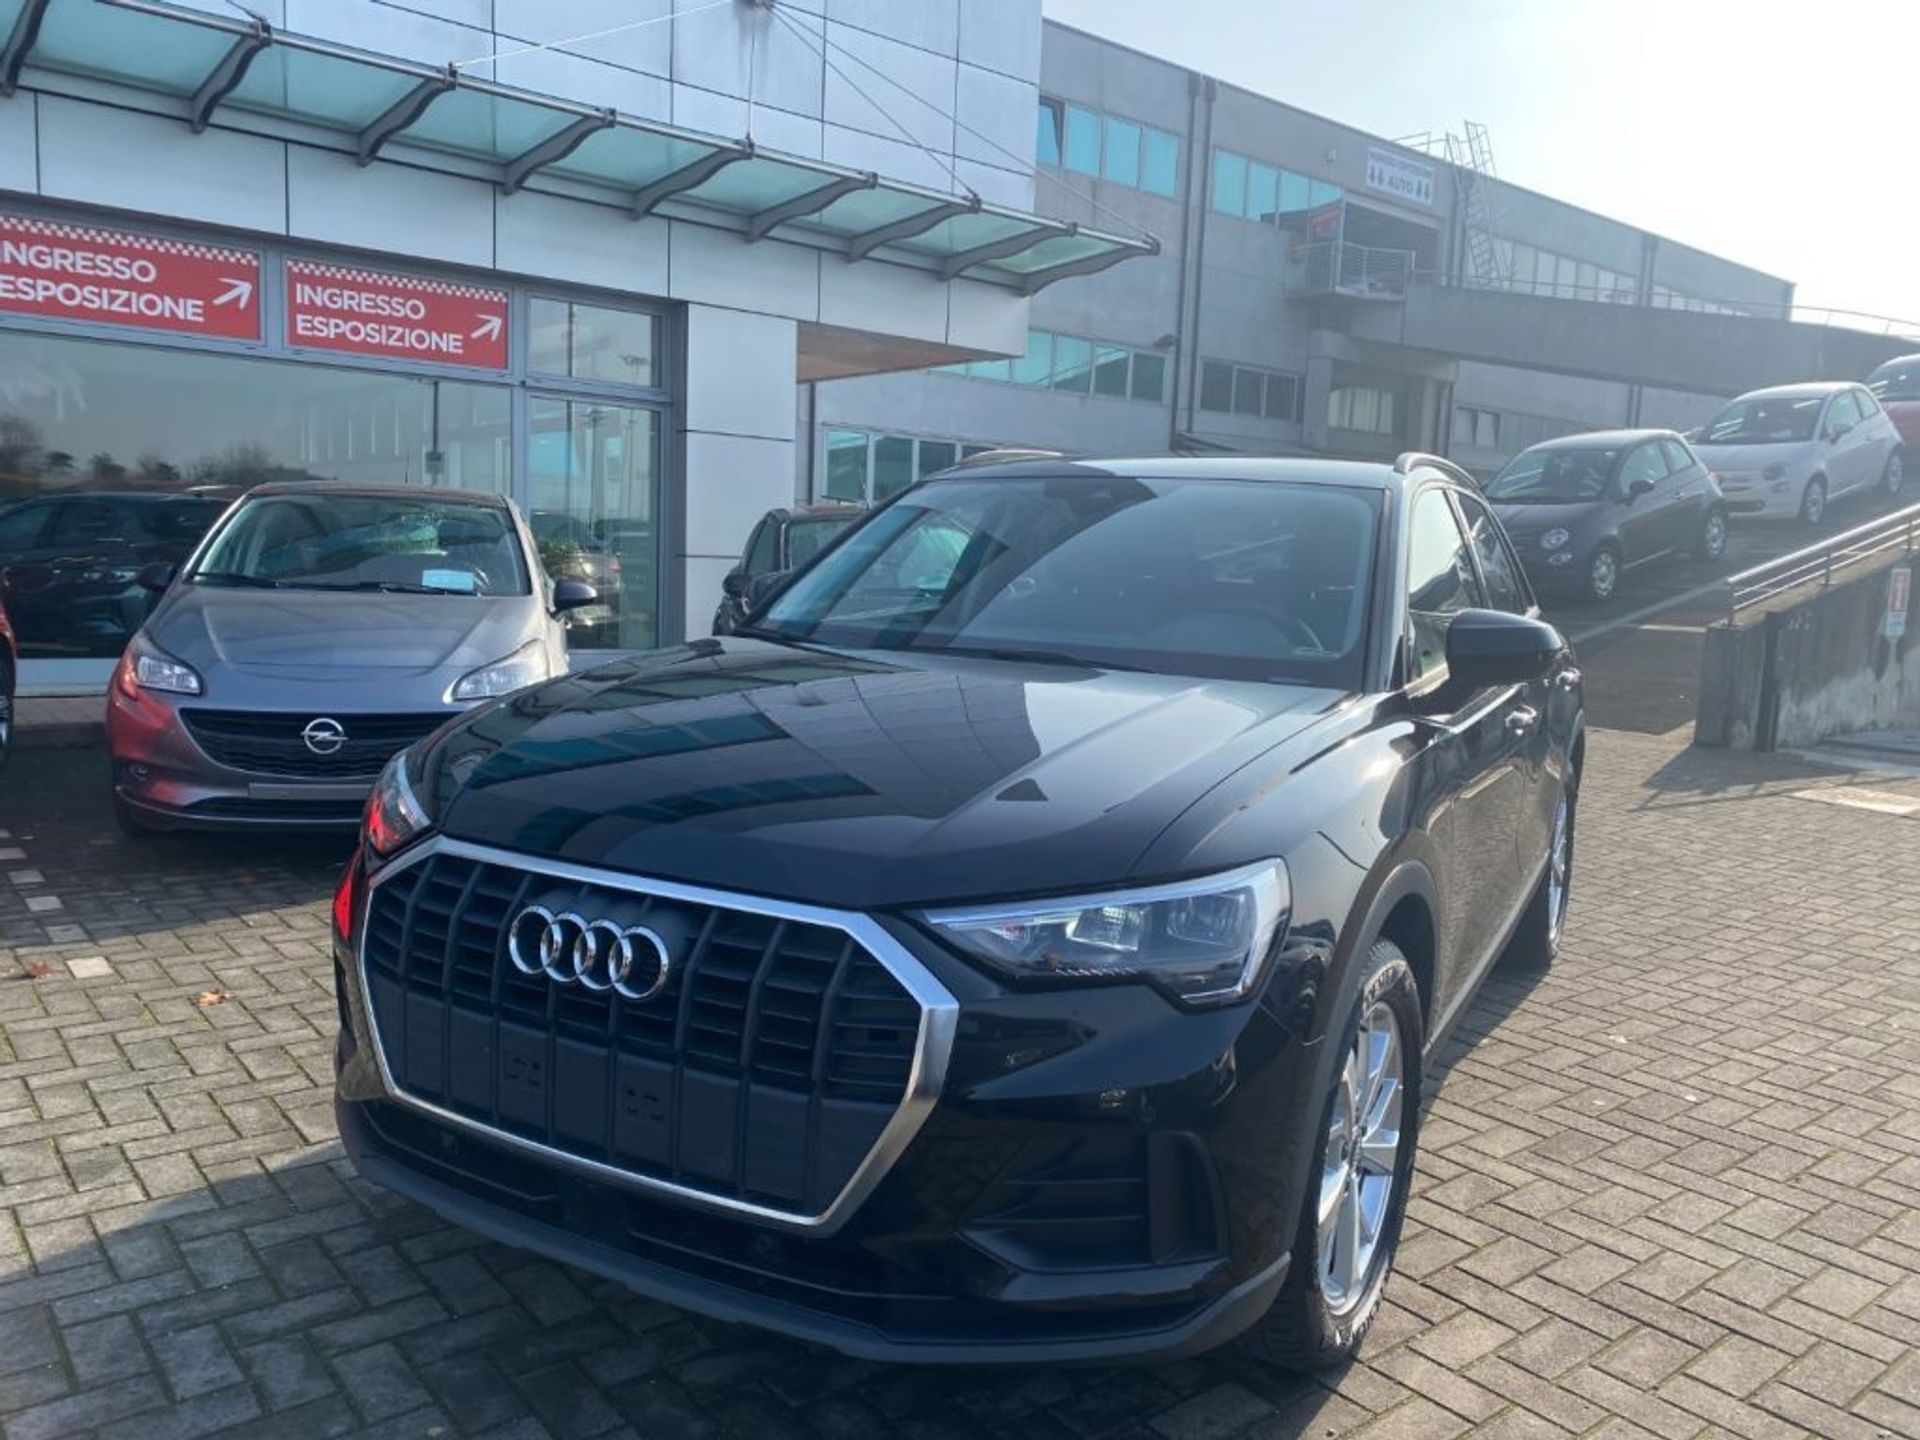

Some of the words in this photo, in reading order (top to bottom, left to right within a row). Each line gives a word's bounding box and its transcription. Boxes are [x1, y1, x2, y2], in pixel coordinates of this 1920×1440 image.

[0, 240, 157, 283] NGRESSO
[0, 274, 205, 323] ESPOSIZIONE
[295, 284, 426, 320] INGRESSO
[296, 314, 465, 354] ESPOSIZIONE
